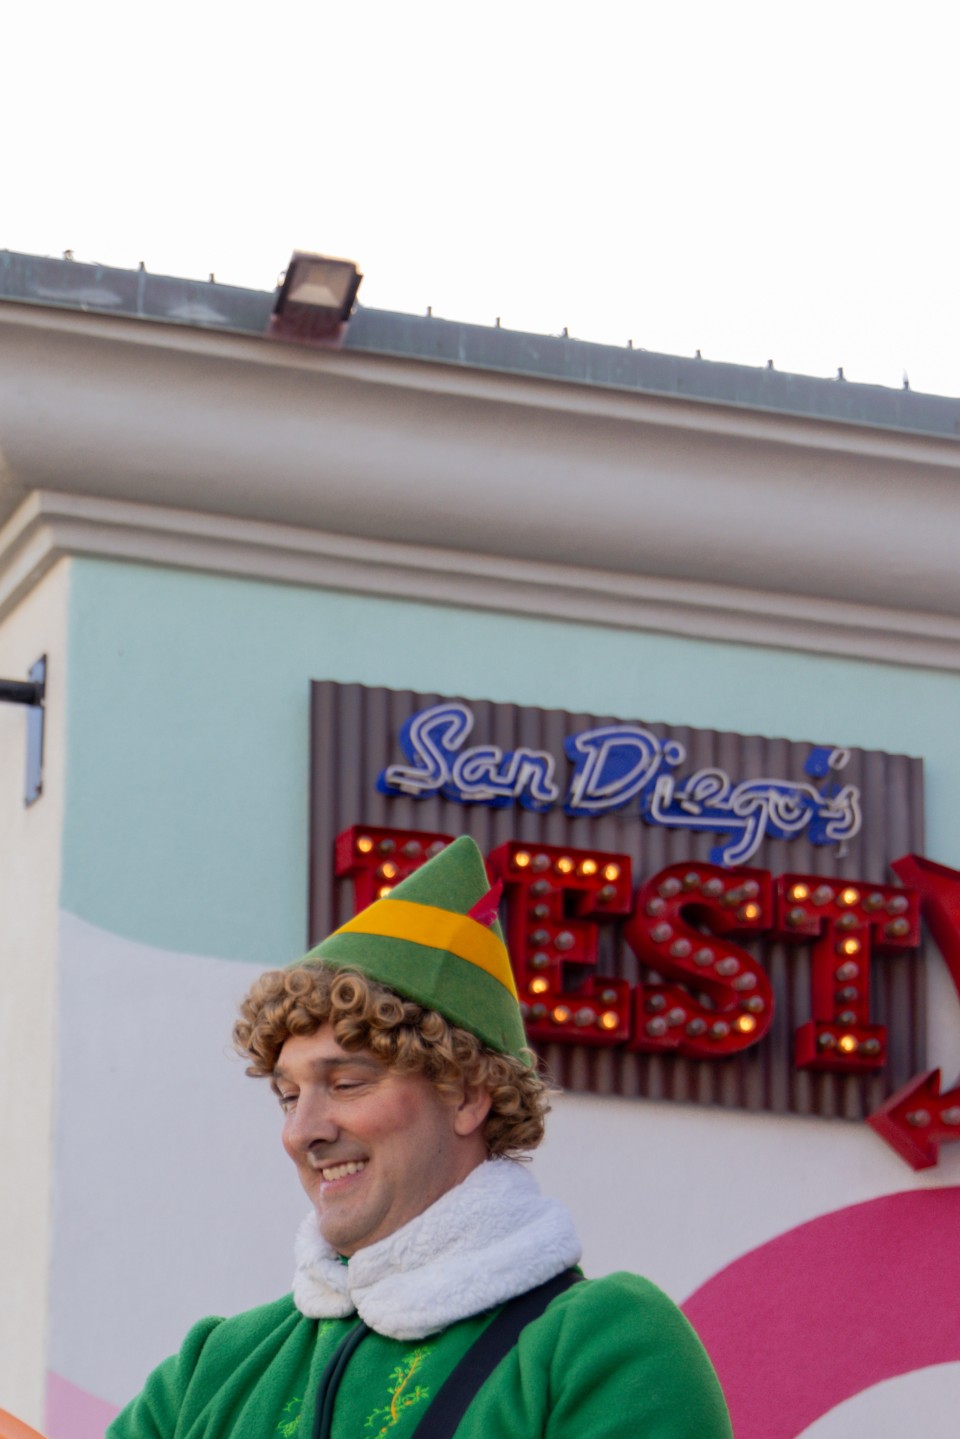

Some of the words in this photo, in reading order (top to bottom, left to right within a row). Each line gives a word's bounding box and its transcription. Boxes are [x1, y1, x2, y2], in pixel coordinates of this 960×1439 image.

[376, 702, 558, 811] San
[564, 725, 862, 866] Diego's
[335, 825, 920, 1072] EST
